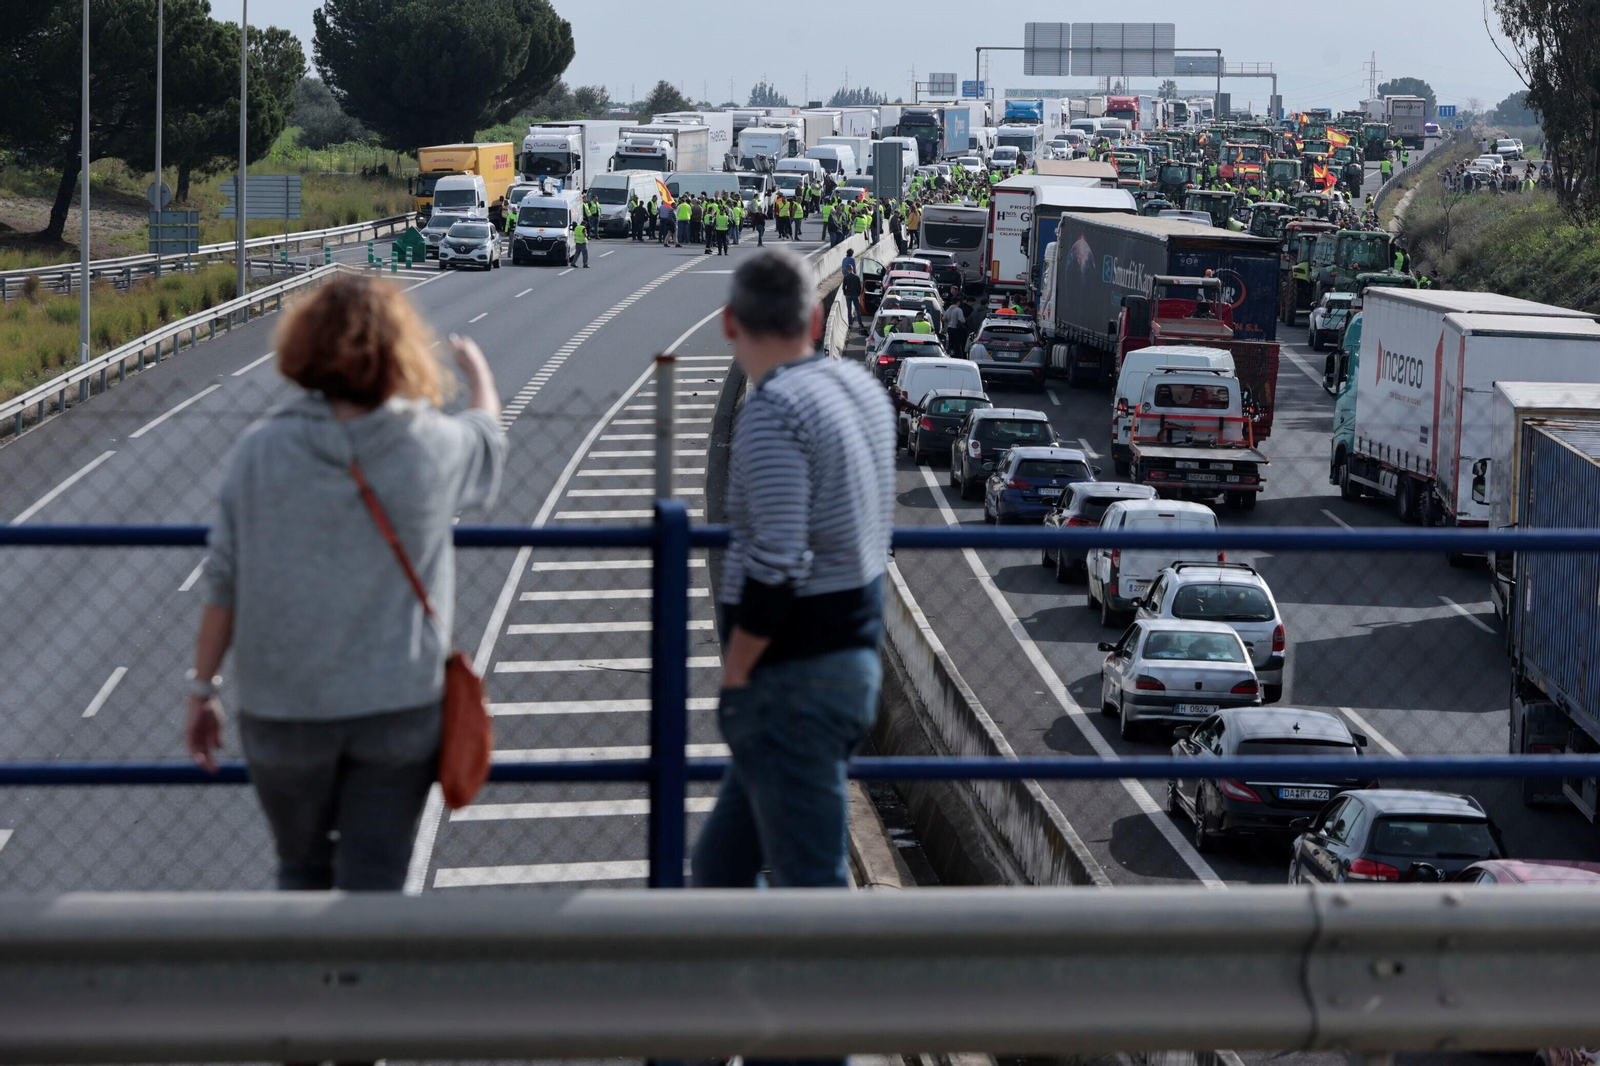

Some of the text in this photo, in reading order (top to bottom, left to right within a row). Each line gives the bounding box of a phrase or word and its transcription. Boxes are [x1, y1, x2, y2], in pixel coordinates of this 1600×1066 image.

[1043, 89, 1060, 97] LORETO
[1112, 257, 1137, 290] Smurfit
[1190, 705, 1208, 713] 0924
[1313, 790, 1328, 799] 422
[1533, 793, 1568, 802] SCAN
